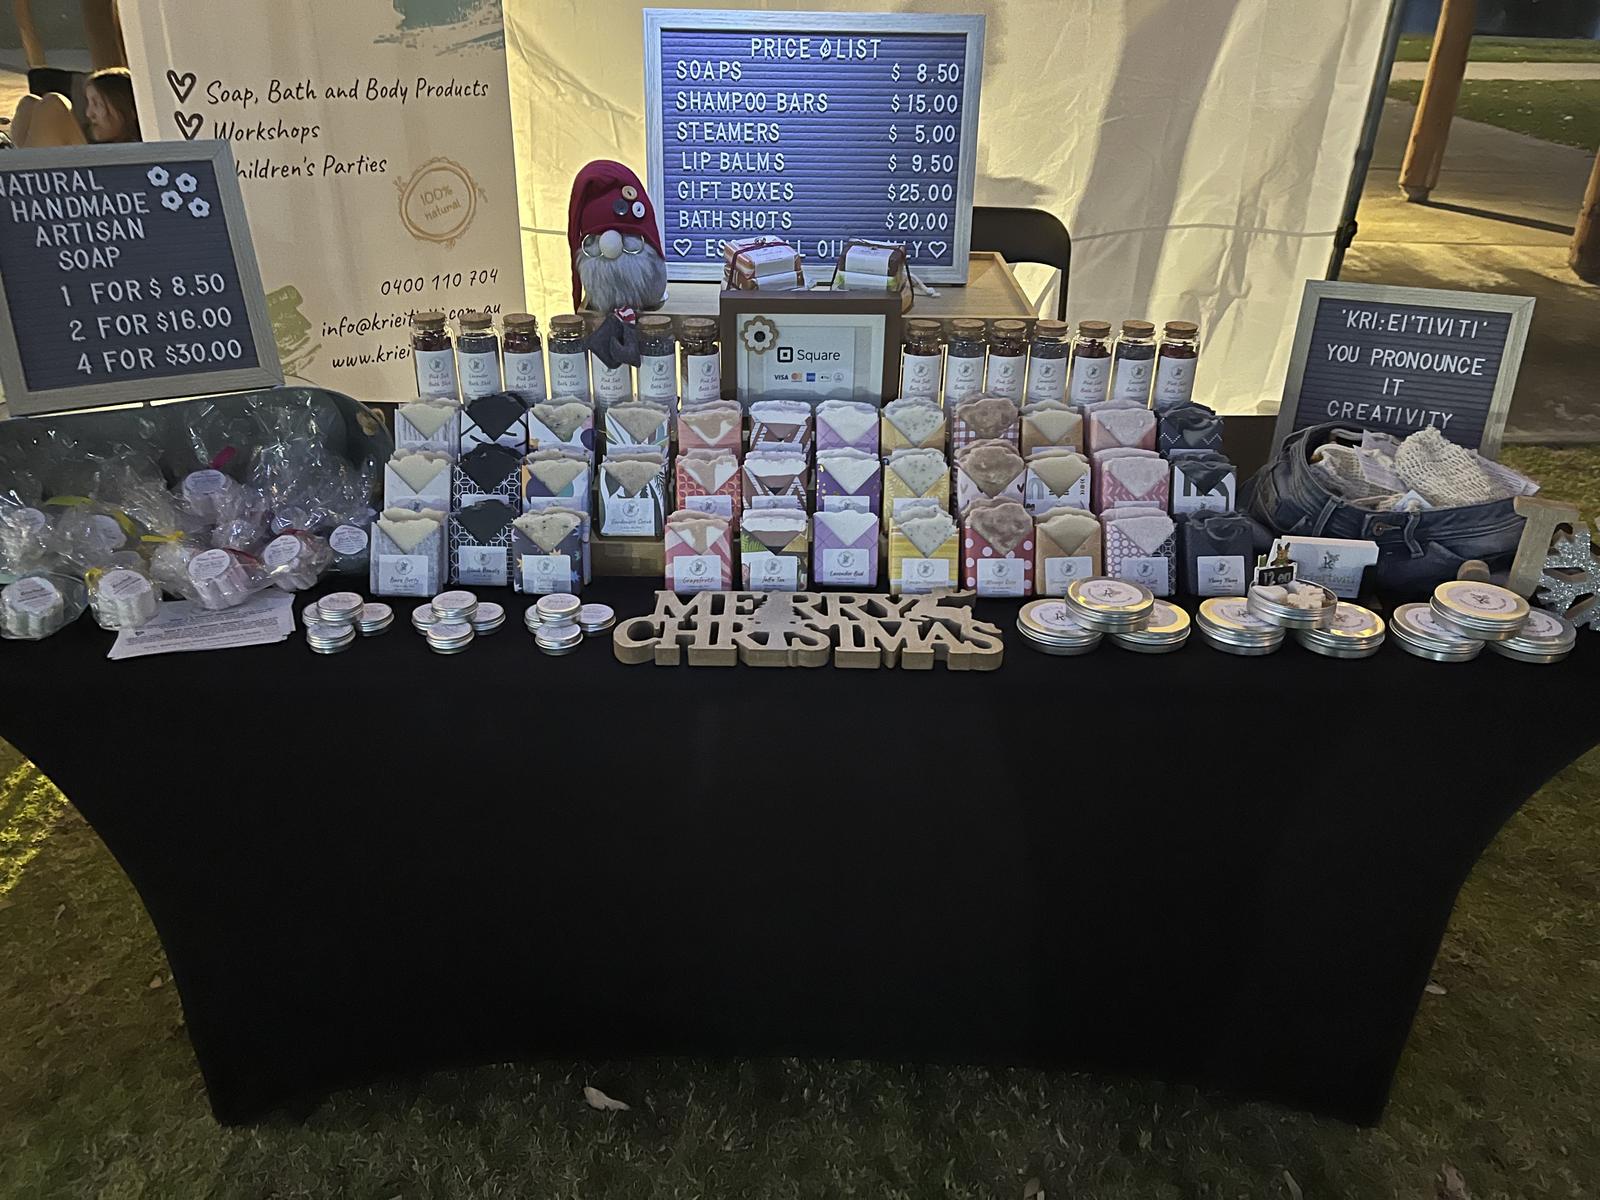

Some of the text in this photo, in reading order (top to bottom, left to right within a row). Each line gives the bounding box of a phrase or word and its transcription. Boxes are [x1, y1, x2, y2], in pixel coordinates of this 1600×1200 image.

[751, 38, 881, 59] PRICE LIST
[676, 60, 742, 82] SOAPS
[917, 64, 960, 83] 8.50
[206, 78, 488, 108] Soap, Bath and Body Products
[676, 91, 766, 112] SHAMPOO
[777, 93, 828, 112] BARS
[213, 120, 320, 144] Workshops
[677, 122, 780, 142] STEAMERS
[236, 155, 387, 179] hildren's Parties
[682, 151, 711, 171] LIP
[720, 152, 785, 172] BALMS
[420, 186, 453, 206] 100%
[677, 181, 721, 200] GIFT
[732, 182, 794, 201] BOXES
[10, 192, 150, 223] HANDMADE
[424, 198, 460, 220] natural
[680, 210, 722, 228] BATH
[730, 211, 792, 230] SHOTS
[36, 218, 145, 247] ARTISAN
[59, 246, 120, 271] SOAP
[60, 286, 72, 306] 1
[90, 280, 143, 304] FOR
[381, 268, 498, 296] 0400 110 704
[70, 306, 232, 342] 2 FOR $16.00
[78, 339, 242, 374] 4 FOR $30.00
[797, 350, 840, 363] Square
[1327, 344, 1486, 376] YOU PRONOUNCE
[1382, 377, 1404, 396] IT
[1328, 400, 1453, 430] CREATIVITY
[654, 590, 925, 622] MERRY
